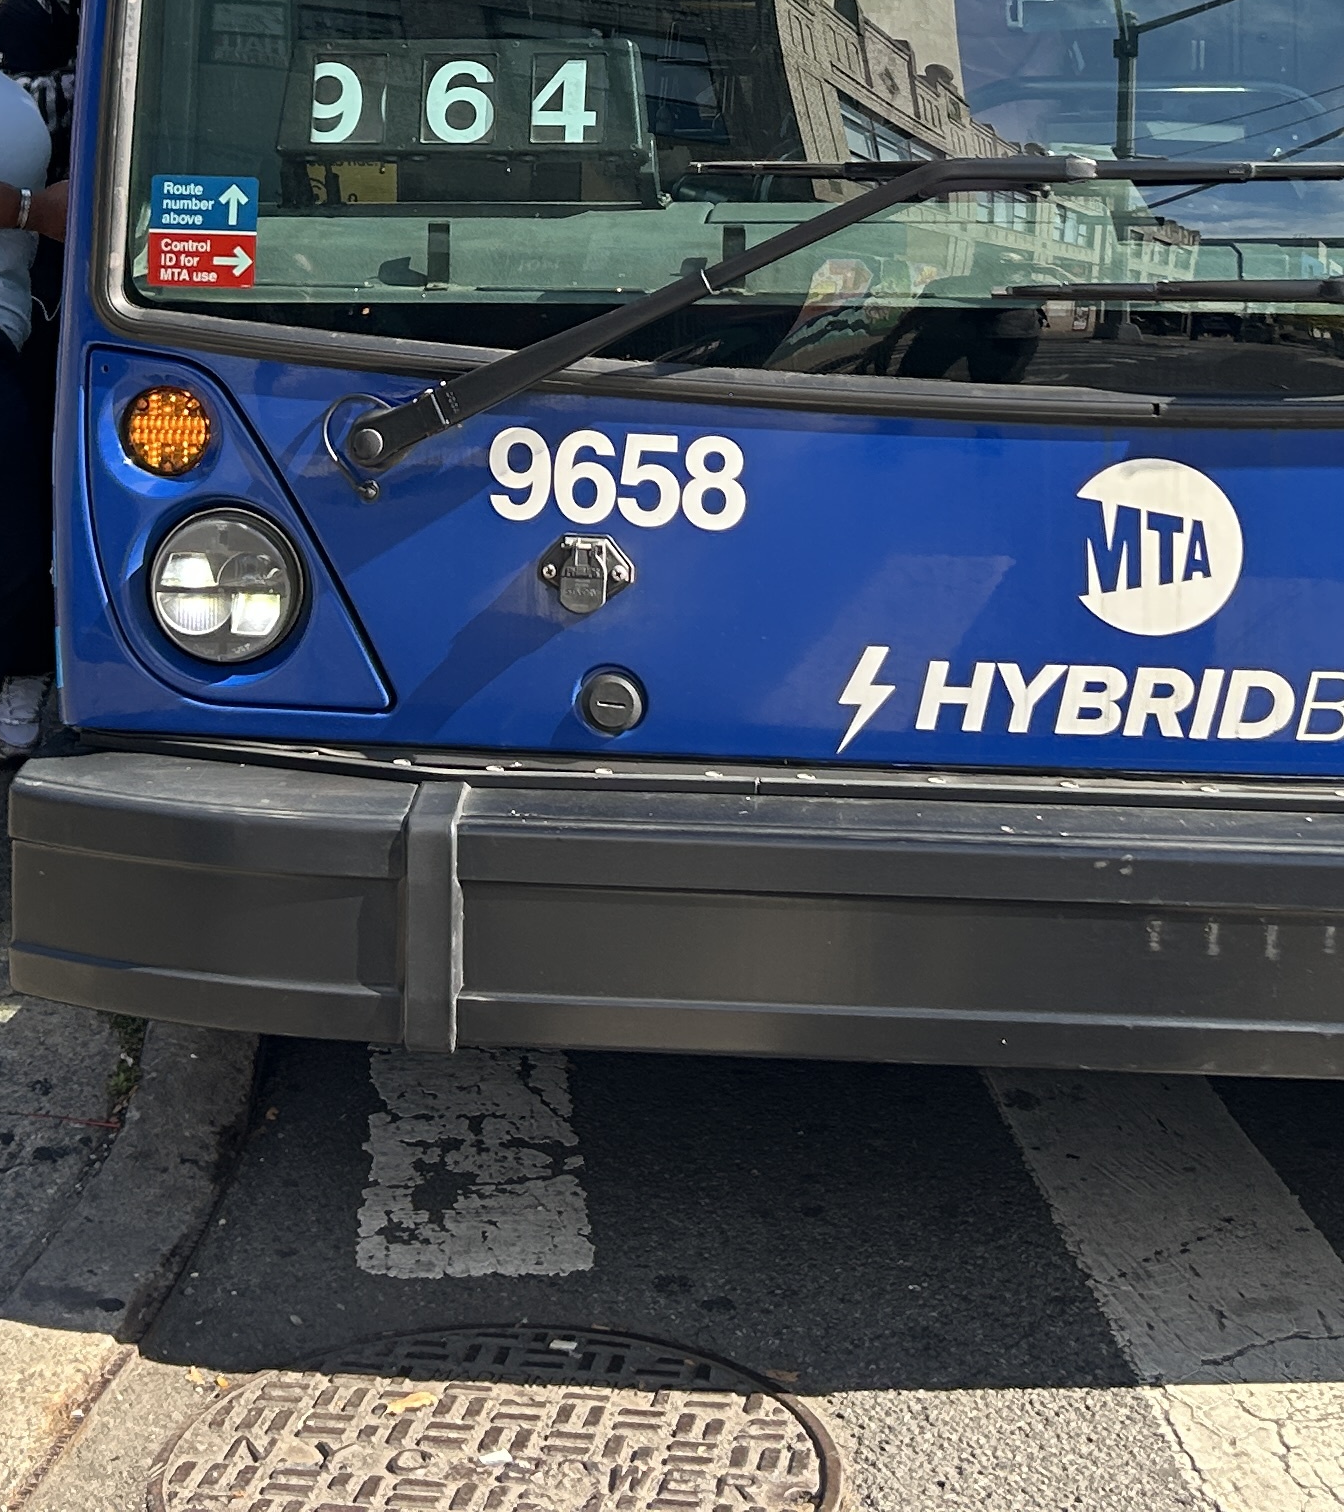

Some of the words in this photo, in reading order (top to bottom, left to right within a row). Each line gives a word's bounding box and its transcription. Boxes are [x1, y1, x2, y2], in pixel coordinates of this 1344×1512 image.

[163, 181, 204, 196] Route
[162, 198, 215, 210] number
[161, 212, 203, 225] above
[161, 238, 211, 252] Control
[161, 253, 176, 266] ID
[180, 254, 200, 267] for
[160, 268, 190, 281] MTA
[193, 272, 218, 282] use
[488, 426, 747, 531] 9658
[1079, 501, 1213, 596] MTA
